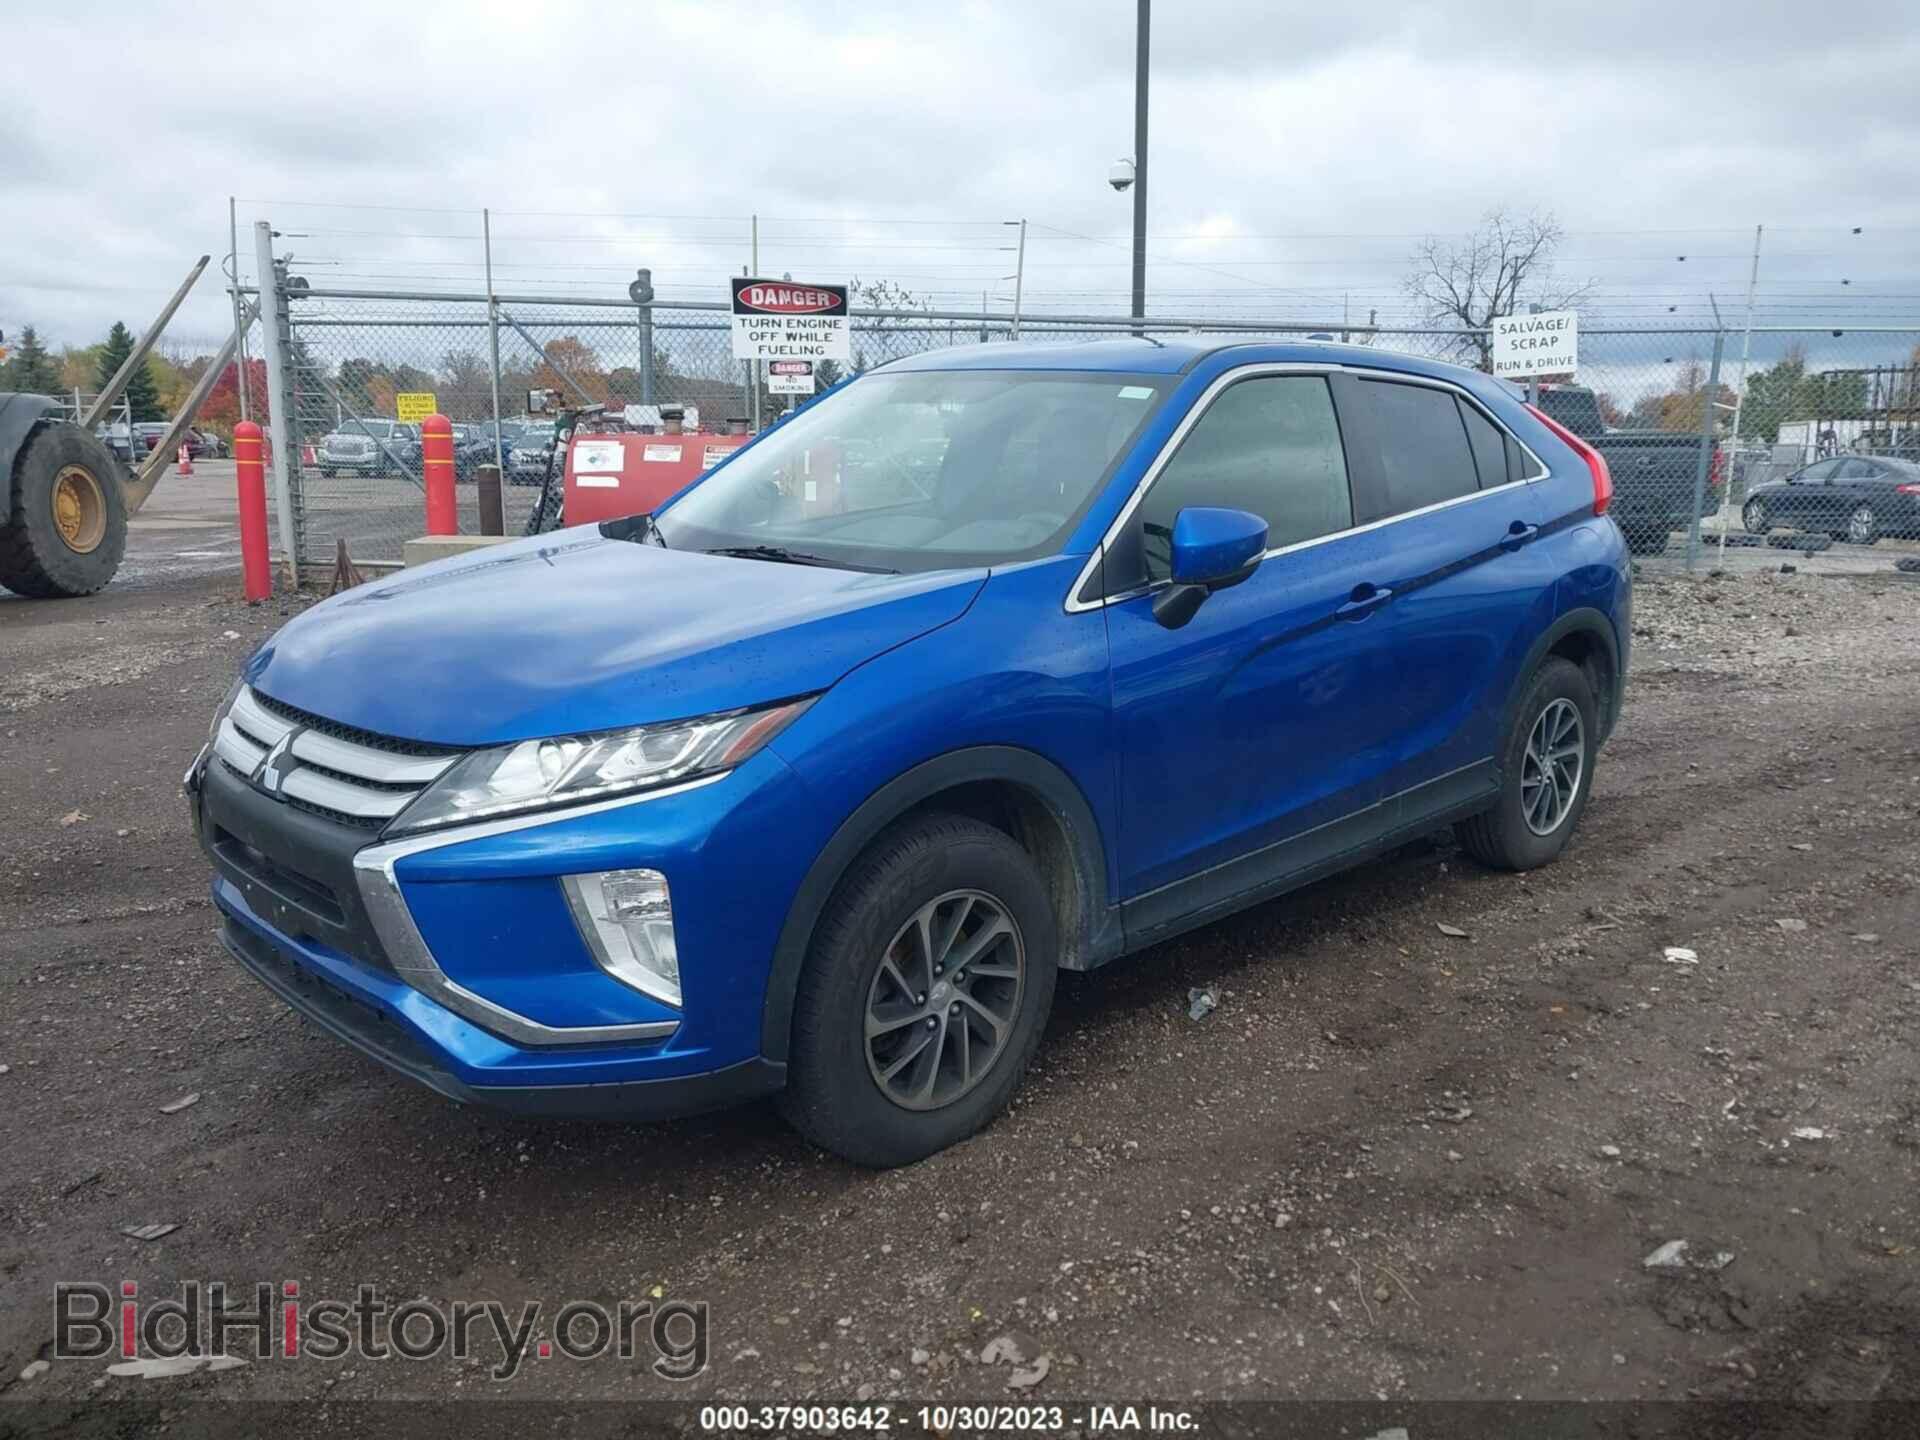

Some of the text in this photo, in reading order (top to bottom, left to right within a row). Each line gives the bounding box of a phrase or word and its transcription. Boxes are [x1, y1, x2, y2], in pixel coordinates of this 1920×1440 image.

[751, 288, 830, 306] DANGER
[740, 318, 843, 330] TURN ENGINE
[1499, 317, 1570, 335] SALVAGE/
[748, 331, 833, 343] OFF WHILE
[1511, 335, 1559, 351] SCRAP
[758, 344, 826, 356] FUELING
[1496, 355, 1575, 371] RUN & DRIVE
